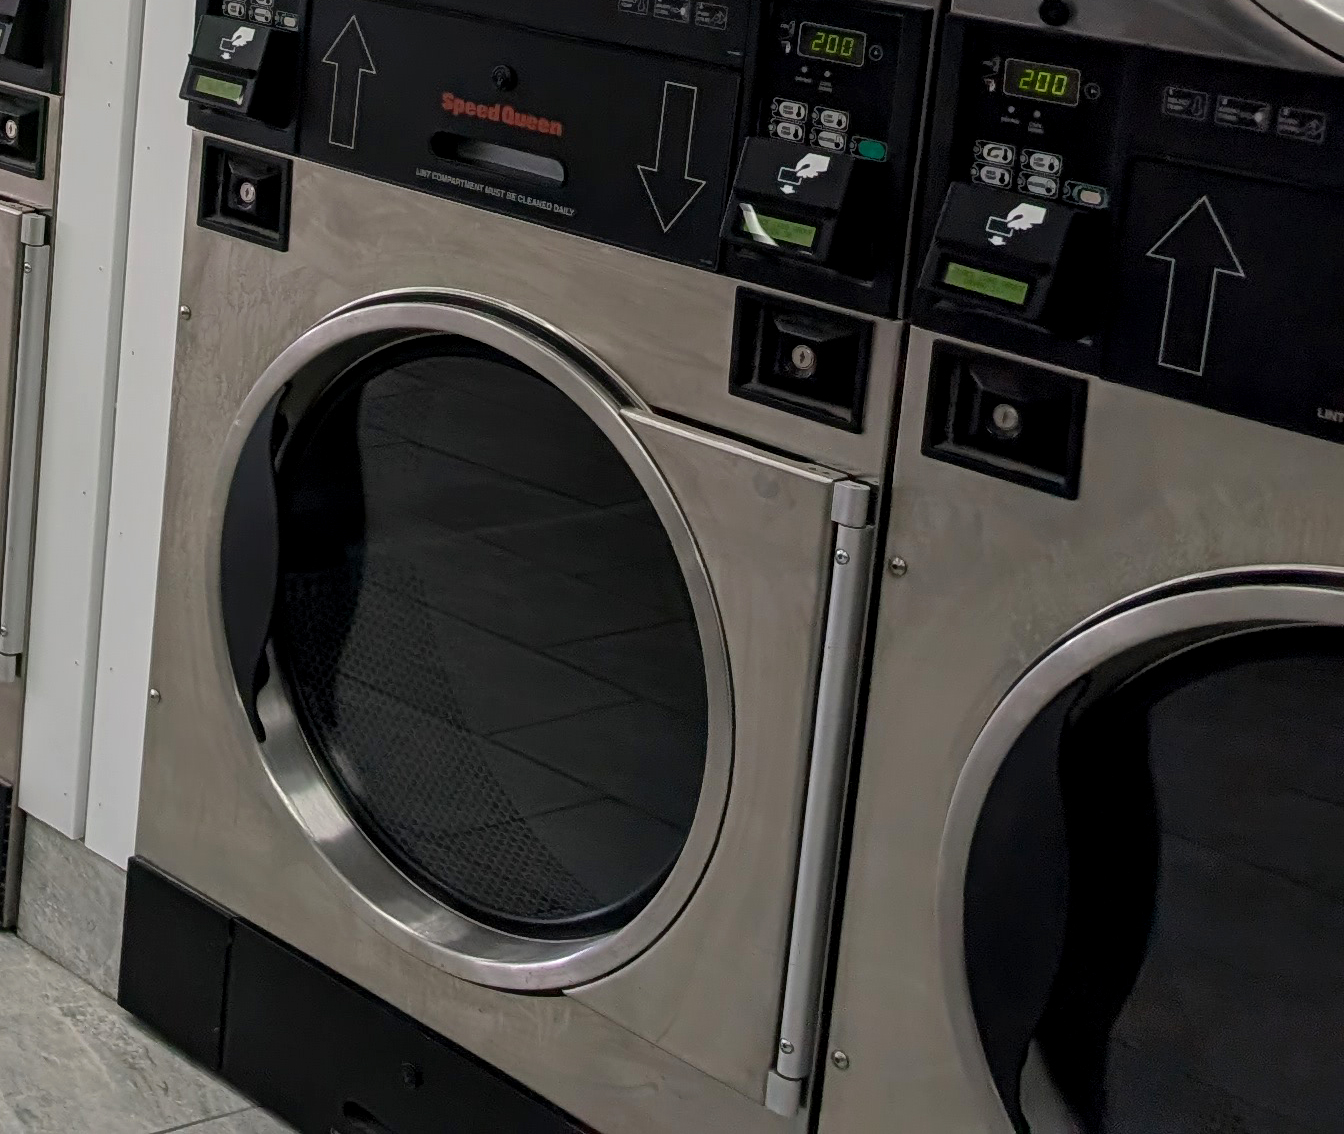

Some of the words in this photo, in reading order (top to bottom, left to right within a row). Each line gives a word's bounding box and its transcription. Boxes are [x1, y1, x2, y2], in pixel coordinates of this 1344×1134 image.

[811, 31, 855, 57] 200
[1018, 69, 1068, 96] 200
[442, 91, 501, 122] Speed
[501, 104, 563, 137] Queen
[415, 167, 431, 179] LINT
[431, 171, 485, 192] COMPARTMENT
[484, 184, 506, 199] MUST
[506, 191, 518, 202] BE
[517, 192, 553, 211] CLEANED
[553, 203, 575, 217] DAILY
